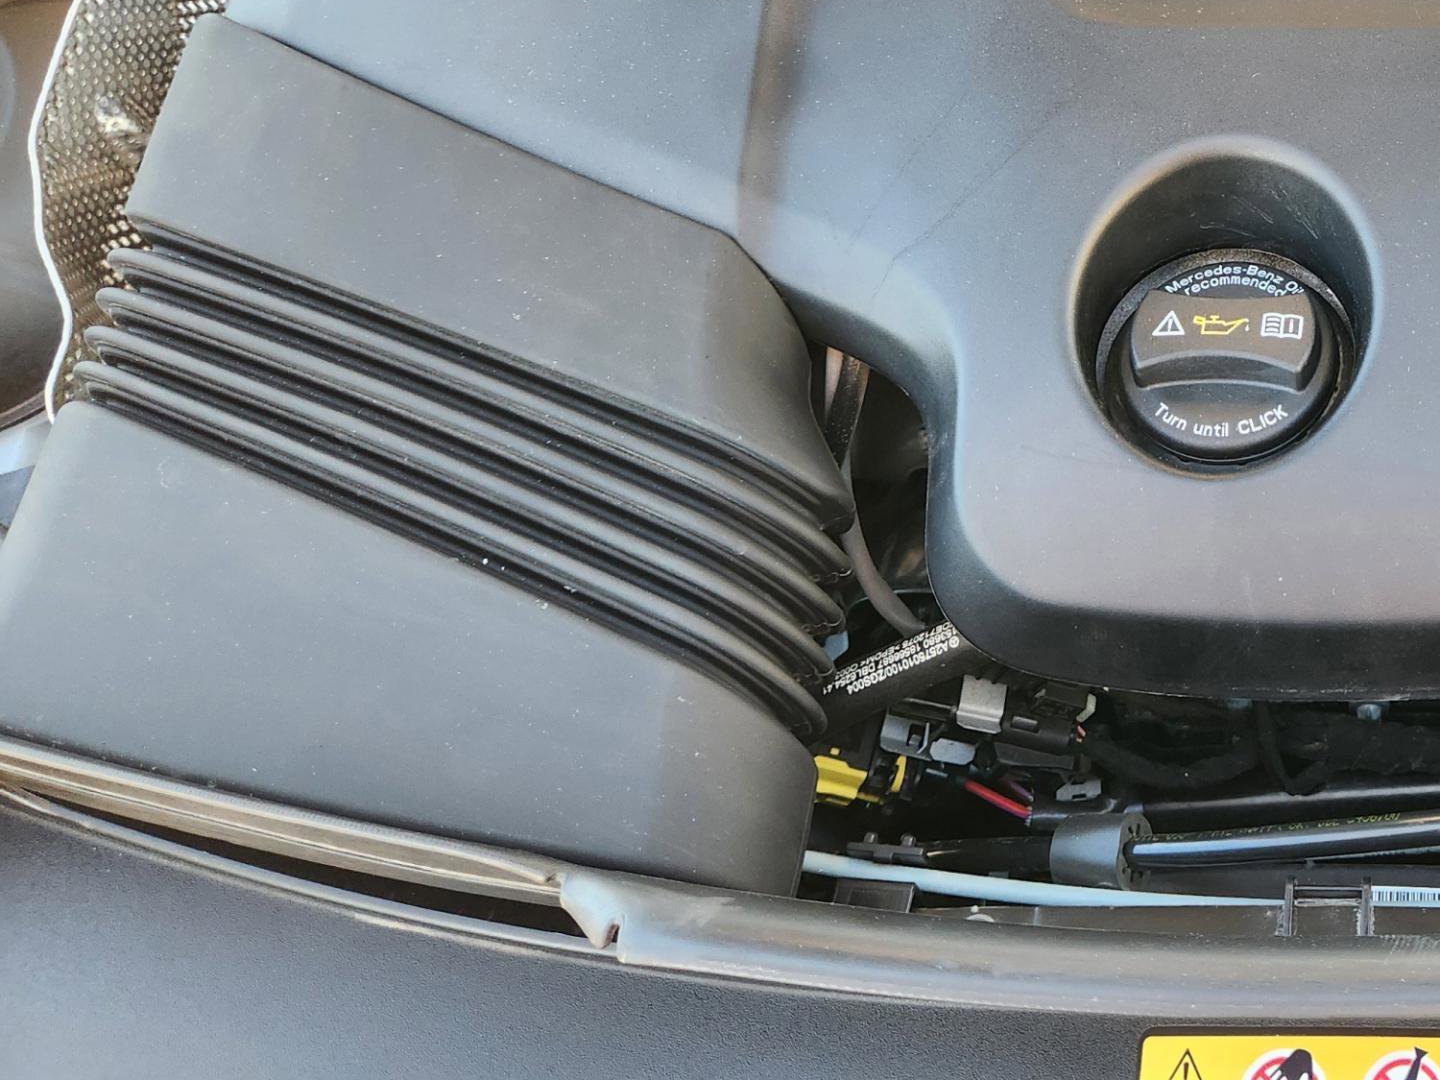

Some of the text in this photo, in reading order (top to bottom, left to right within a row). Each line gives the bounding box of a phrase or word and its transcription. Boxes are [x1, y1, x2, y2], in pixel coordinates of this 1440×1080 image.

[1165, 265, 1305, 295] Mercedes-Benz Oil
[1184, 275, 1288, 297] recommended
[1154, 402, 1289, 437] Turn until CLICK
